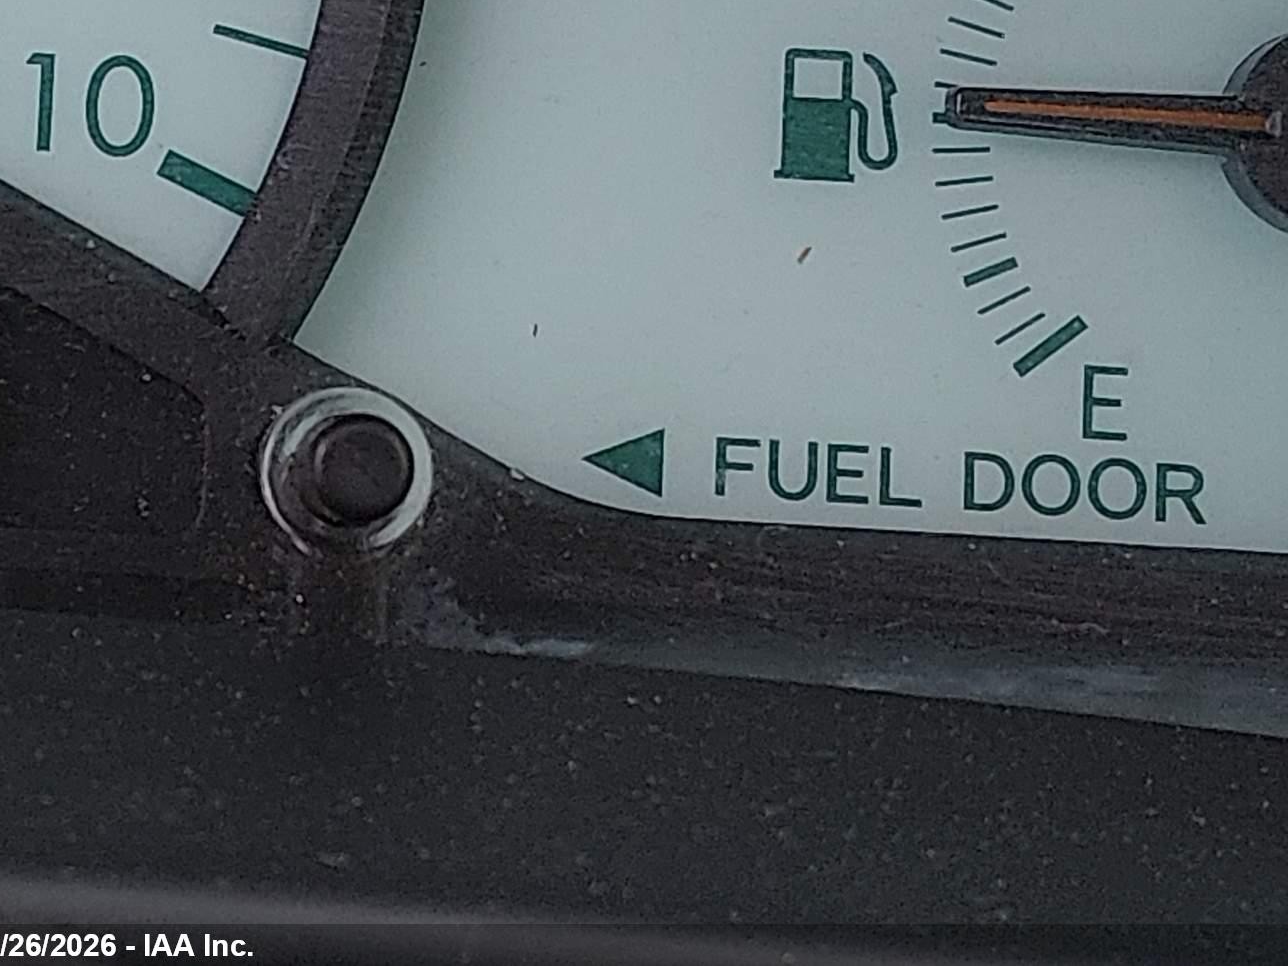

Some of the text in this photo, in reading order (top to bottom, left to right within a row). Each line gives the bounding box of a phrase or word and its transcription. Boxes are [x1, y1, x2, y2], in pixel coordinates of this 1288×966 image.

[1083, 365, 1128, 441] E
[715, 437, 1206, 524] FUEL DOOR
